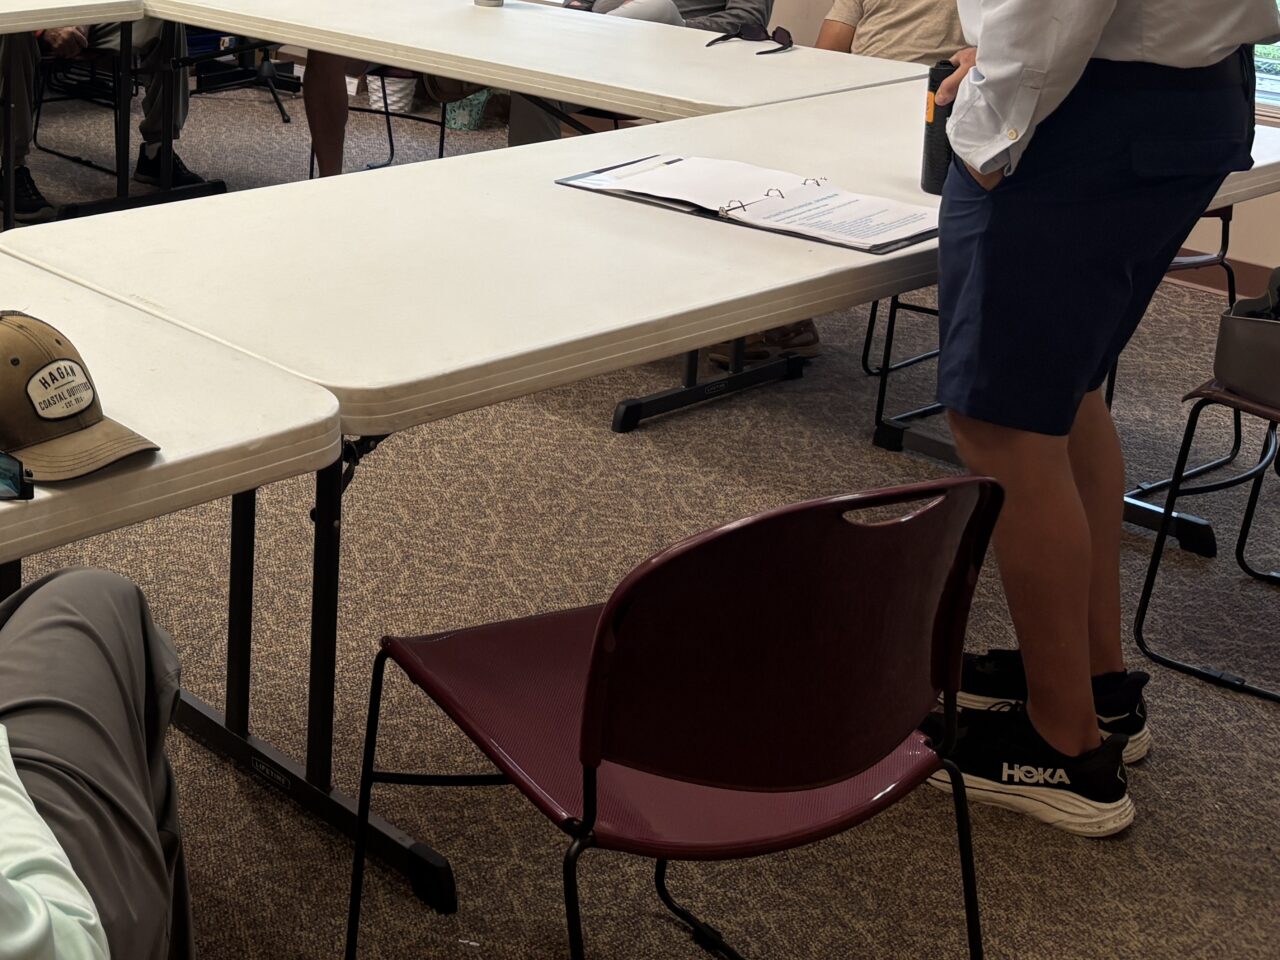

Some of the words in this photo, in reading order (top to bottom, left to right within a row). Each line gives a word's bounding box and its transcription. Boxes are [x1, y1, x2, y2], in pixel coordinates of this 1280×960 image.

[39, 365, 76, 390] HAGAN
[38, 391, 68, 411] COASTAL
[1001, 762, 1071, 785] HOKA
